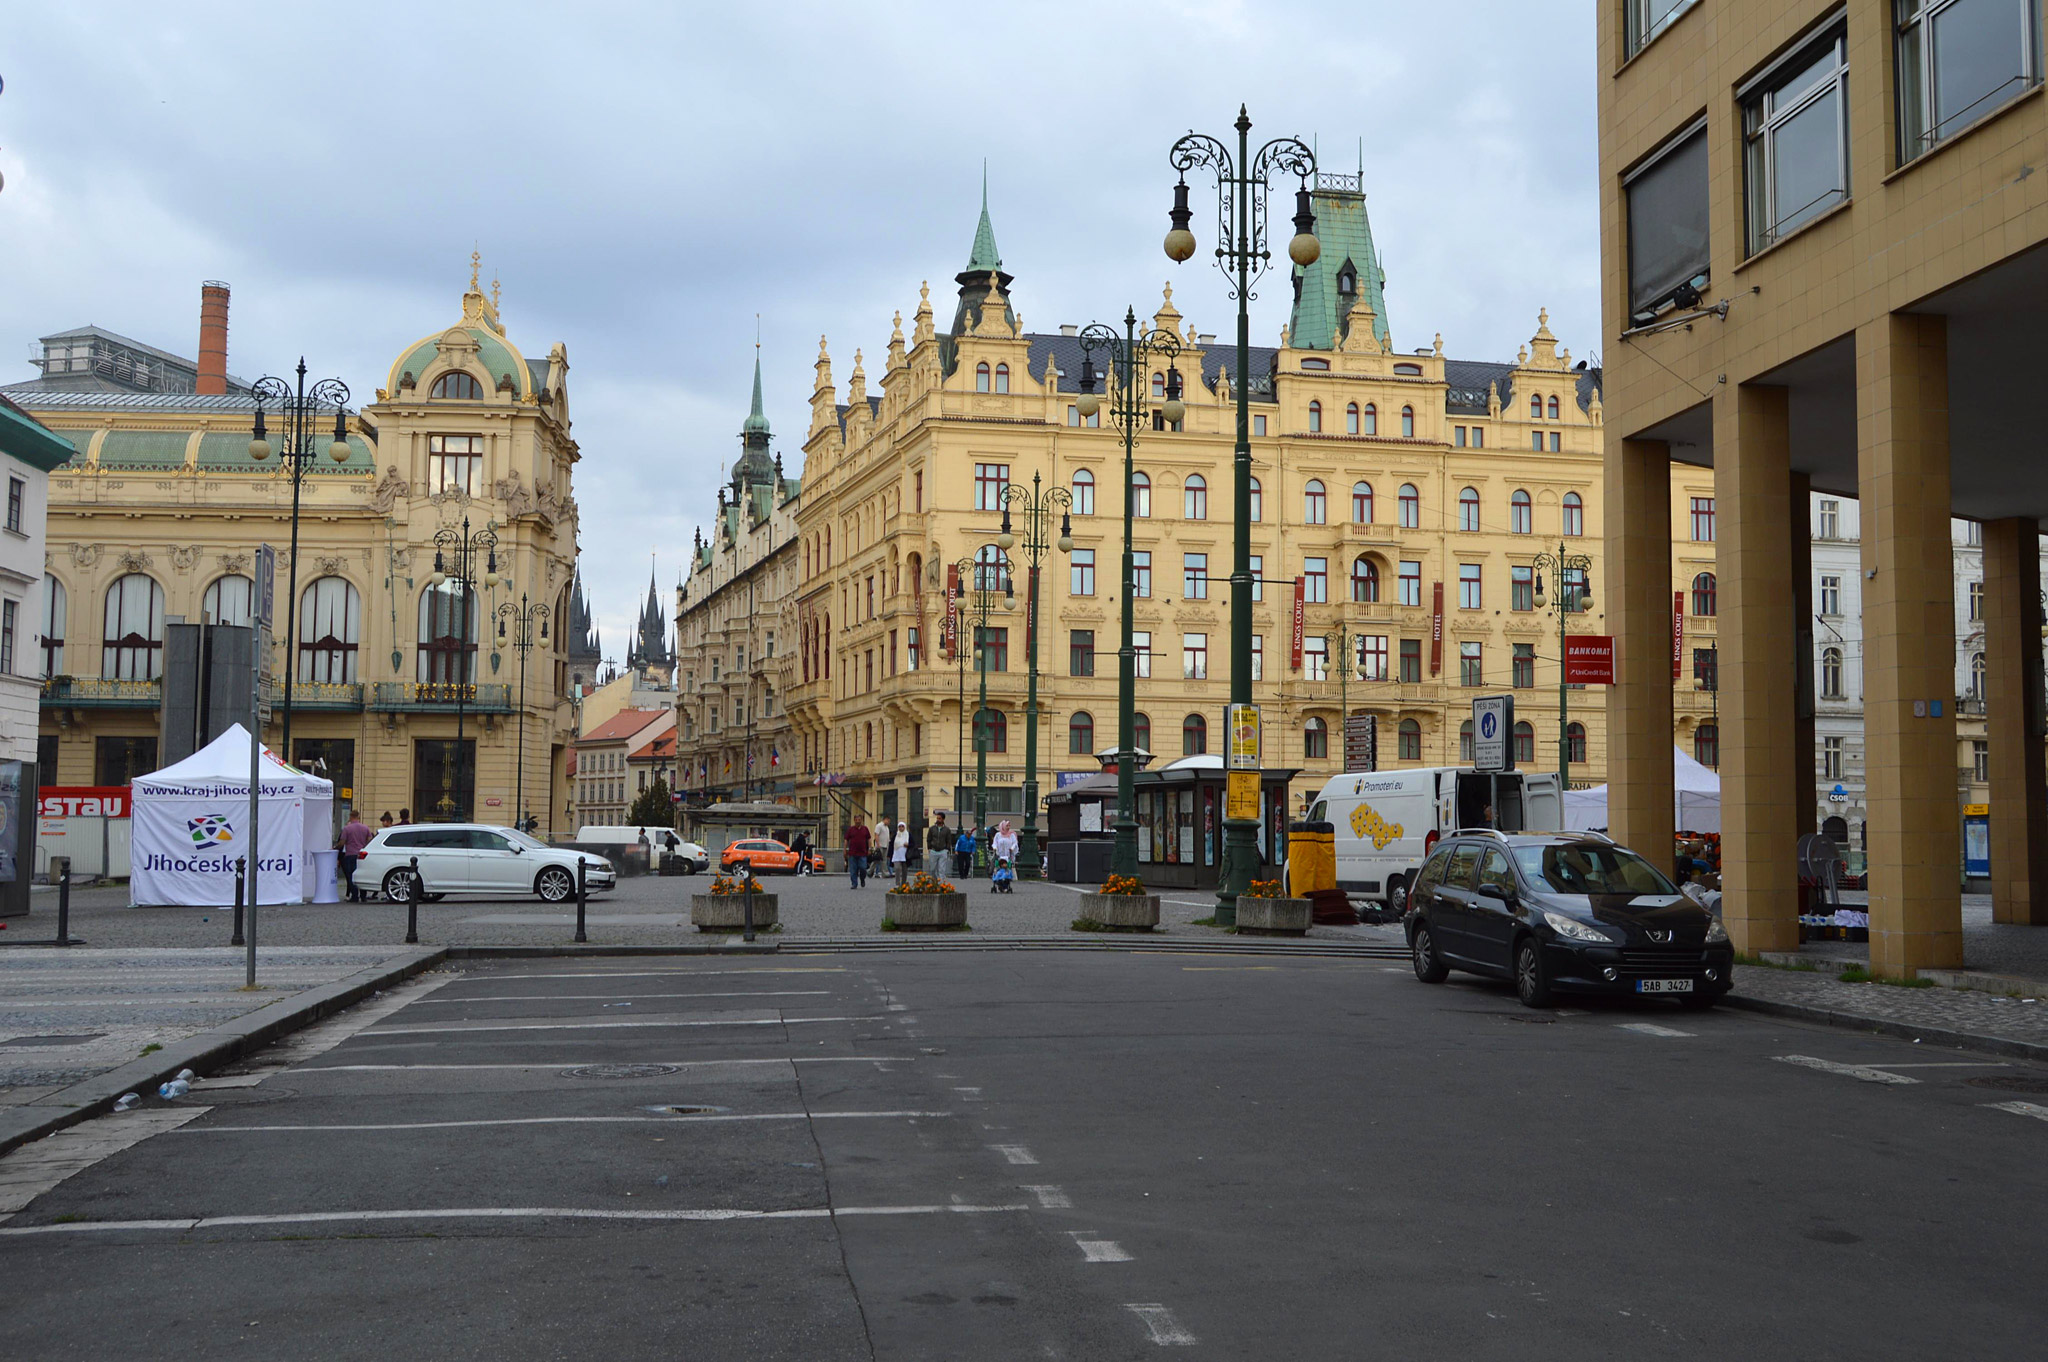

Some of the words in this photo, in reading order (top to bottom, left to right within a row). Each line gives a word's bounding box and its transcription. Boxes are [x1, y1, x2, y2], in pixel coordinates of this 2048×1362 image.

[1295, 598, 1303, 624] COURT
[1433, 613, 1441, 641] HOTEL
[1294, 625, 1302, 650] KINGS
[1568, 647, 1610, 656] BANKOMAT
[965, 773, 1015, 782] BRSSERIE
[143, 784, 294, 798] www.kraj-jihocsky.cz
[144, 854, 247, 873] Jihočesk
[257, 853, 293, 876] kraj
[1643, 981, 1661, 992] 5AB
[1667, 980, 1689, 991] 3427
